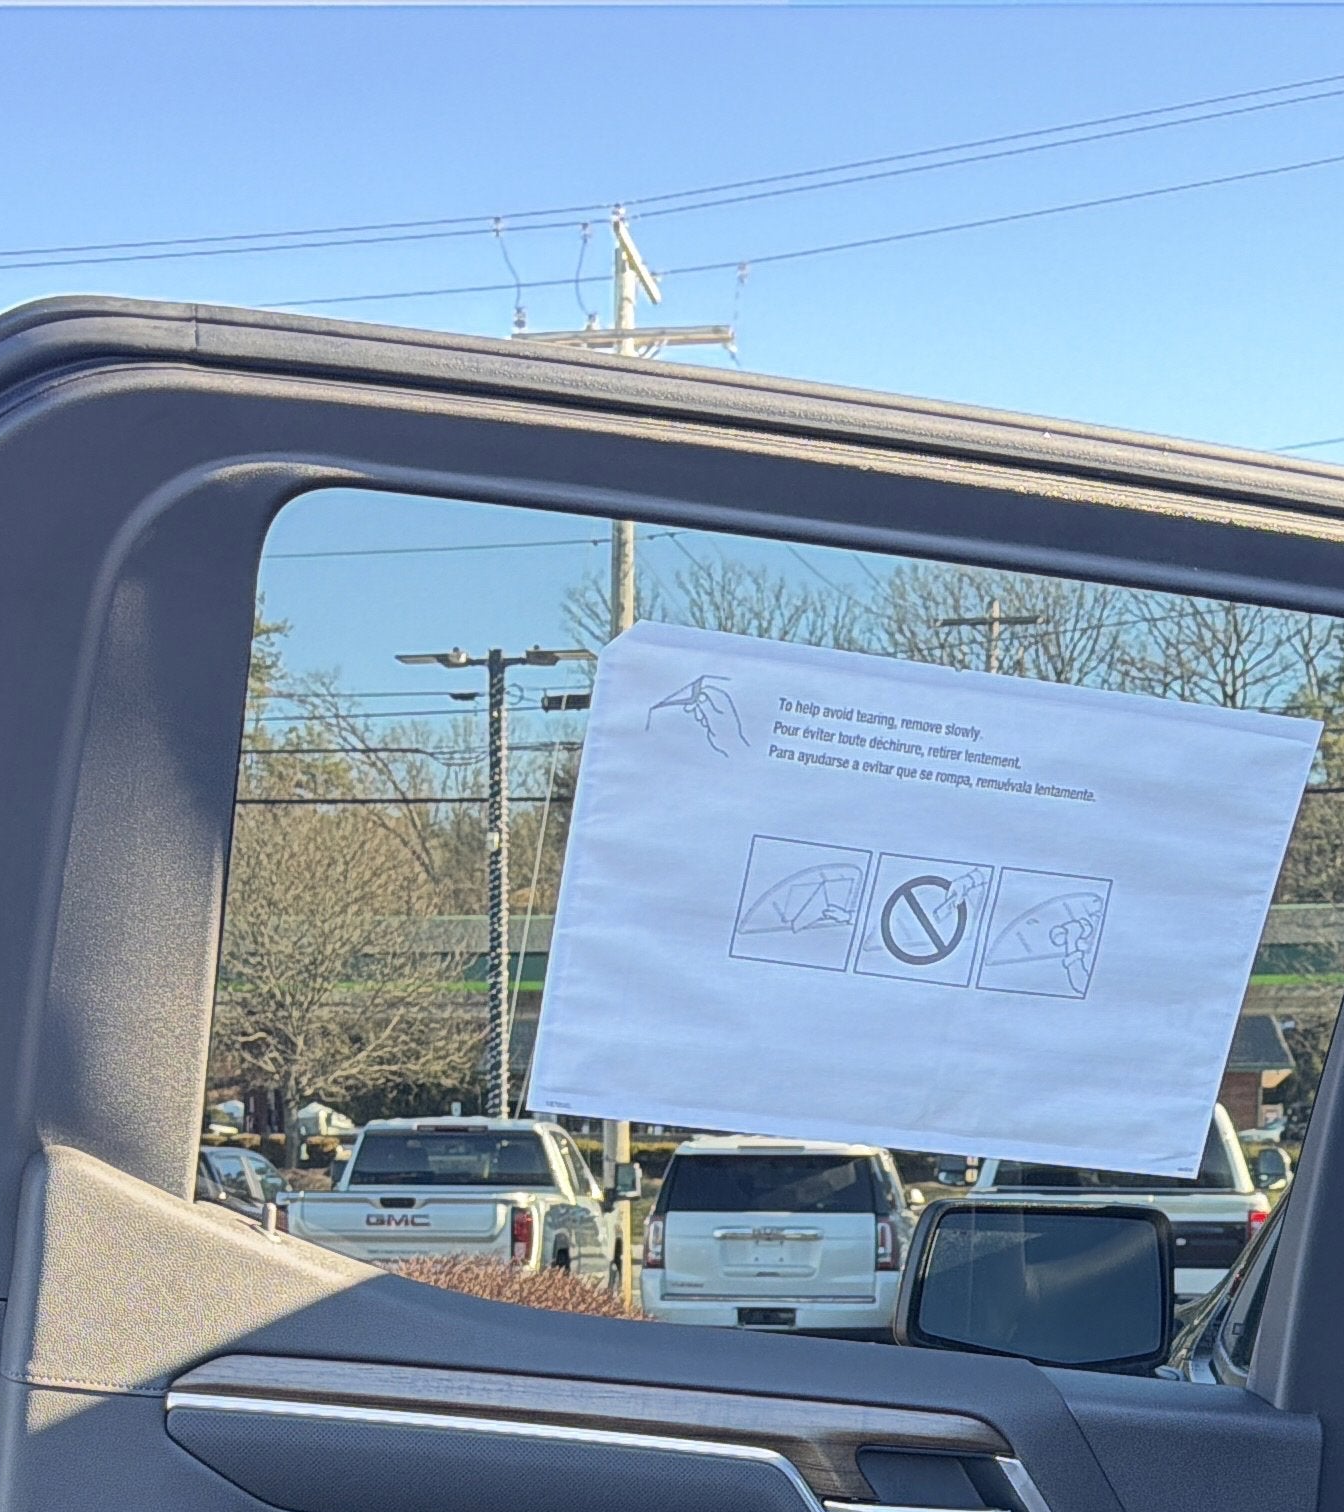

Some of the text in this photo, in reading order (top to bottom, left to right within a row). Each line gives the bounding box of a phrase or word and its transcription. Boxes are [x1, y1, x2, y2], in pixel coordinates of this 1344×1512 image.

[779, 697, 984, 742] To help avoid tearing, remove slowly.
[773, 721, 1021, 769] Pour éviter toute déchirure, retirer lentement.
[768, 744, 1096, 802] Para ayudarse a evitar que se rompa, remuévala lentamente.
[366, 1213, 431, 1227] GMC
